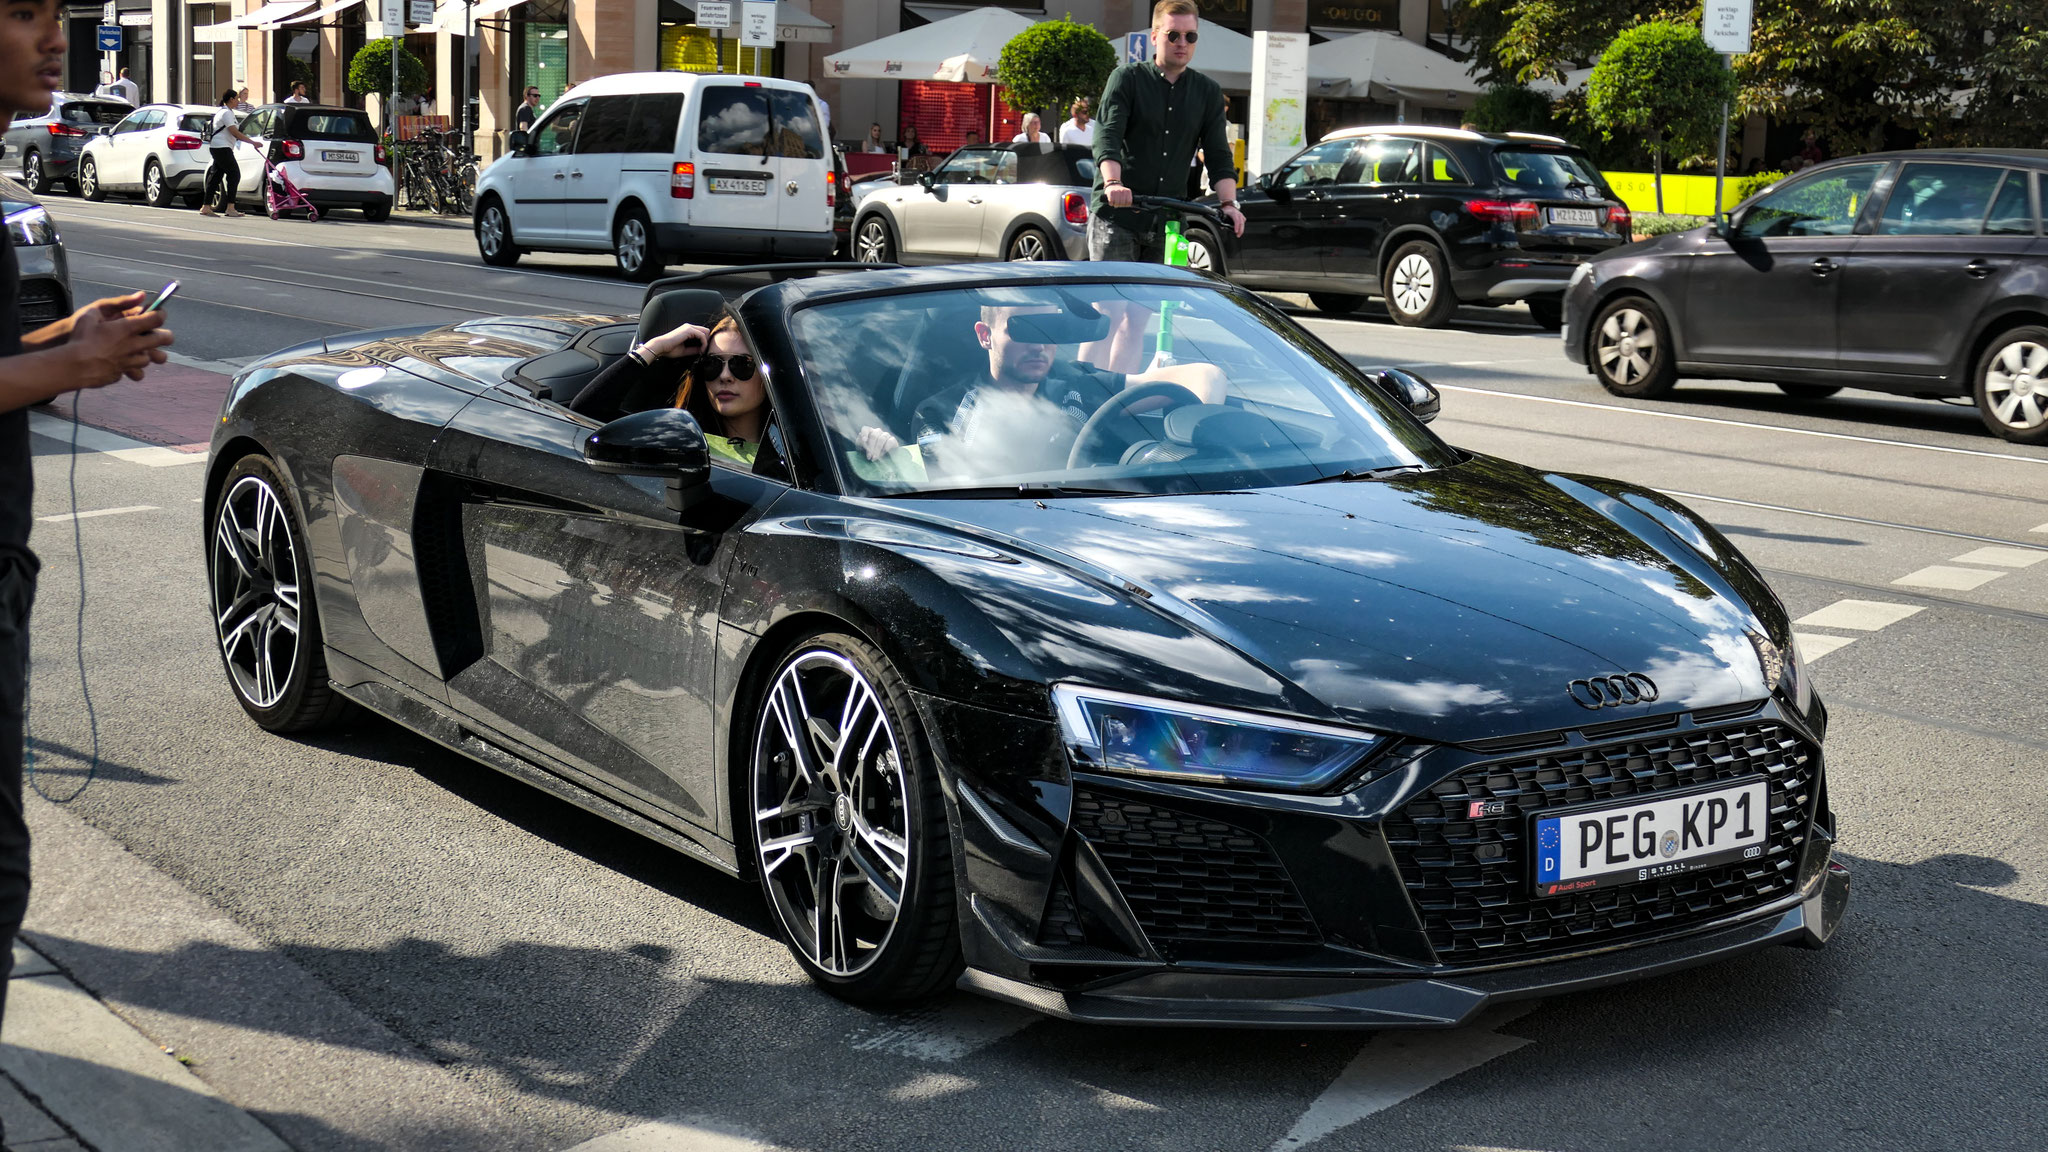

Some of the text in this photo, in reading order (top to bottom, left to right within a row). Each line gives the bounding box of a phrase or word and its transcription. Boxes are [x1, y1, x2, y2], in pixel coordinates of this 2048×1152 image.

[1478, 802, 1505, 816] R8
[1578, 809, 1657, 869] PEG
[1545, 857, 1554, 872] D
[1651, 862, 1686, 875] STOLL
[1558, 880, 1597, 892] Audi Sport
